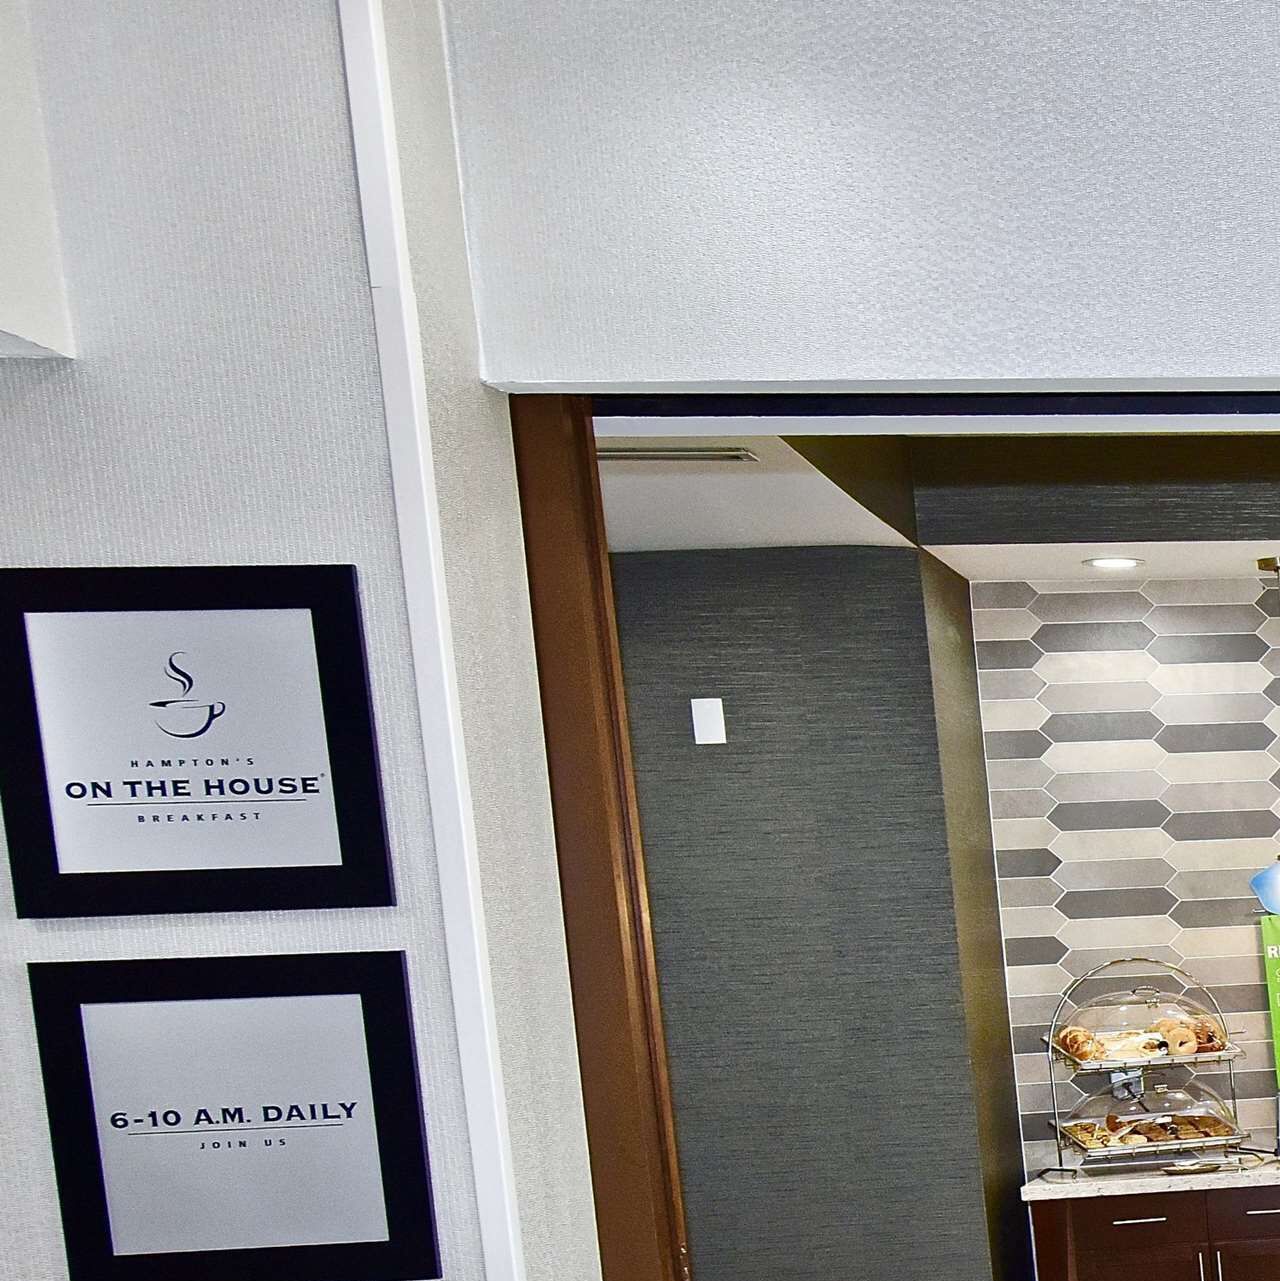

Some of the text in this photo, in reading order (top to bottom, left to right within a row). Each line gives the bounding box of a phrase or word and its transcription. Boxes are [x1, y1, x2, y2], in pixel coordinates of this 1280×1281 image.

[130, 757, 255, 768] HAMPTON'S
[64, 781, 113, 800] ON
[121, 779, 192, 798] THE
[137, 811, 263, 824] BREAKFAST
[109, 1101, 359, 1130] 6-10 A.M. DAILY
[199, 1138, 287, 1150] JOIN US
